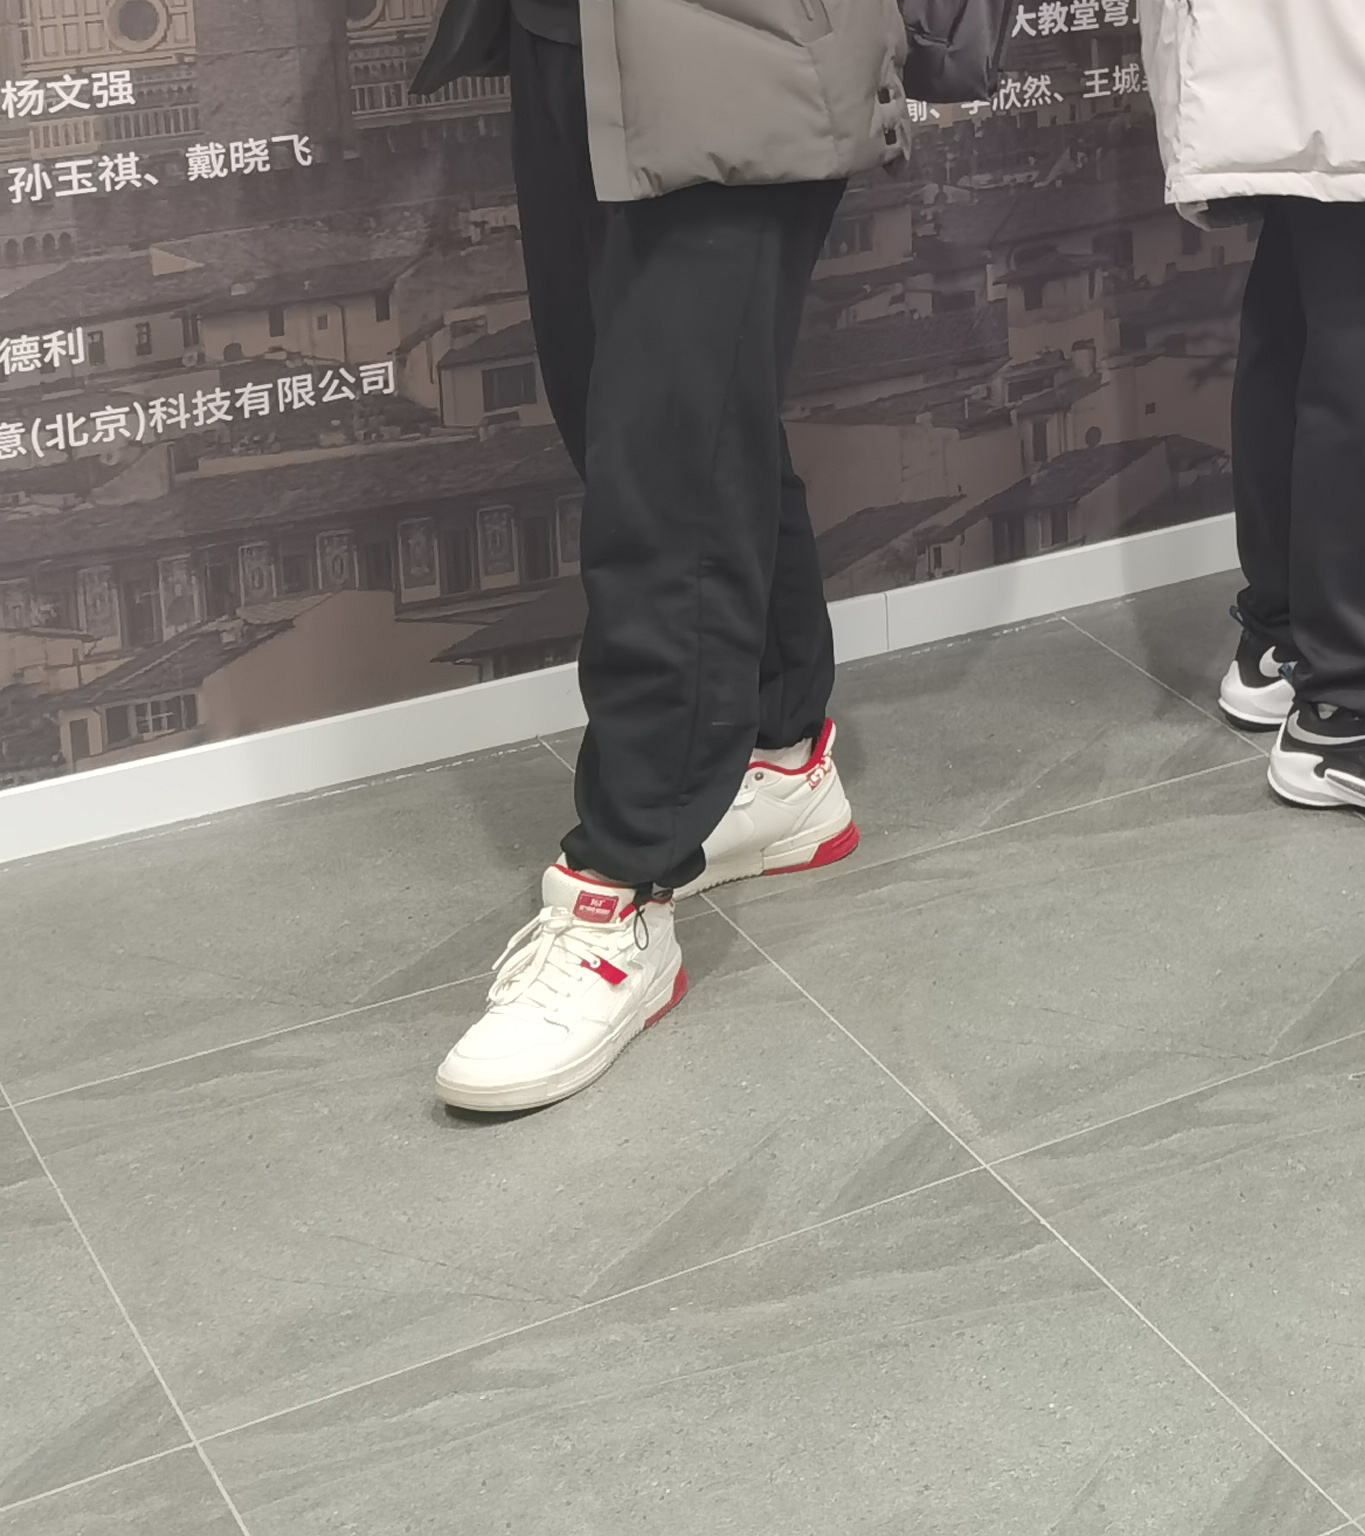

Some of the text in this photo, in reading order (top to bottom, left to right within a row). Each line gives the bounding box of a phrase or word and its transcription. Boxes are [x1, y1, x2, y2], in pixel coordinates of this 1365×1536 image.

[1, 70, 135, 118] 杨文强
[8, 134, 312, 203] 孙玉祺、戴晓飞
[0, 327, 85, 375] 德利
